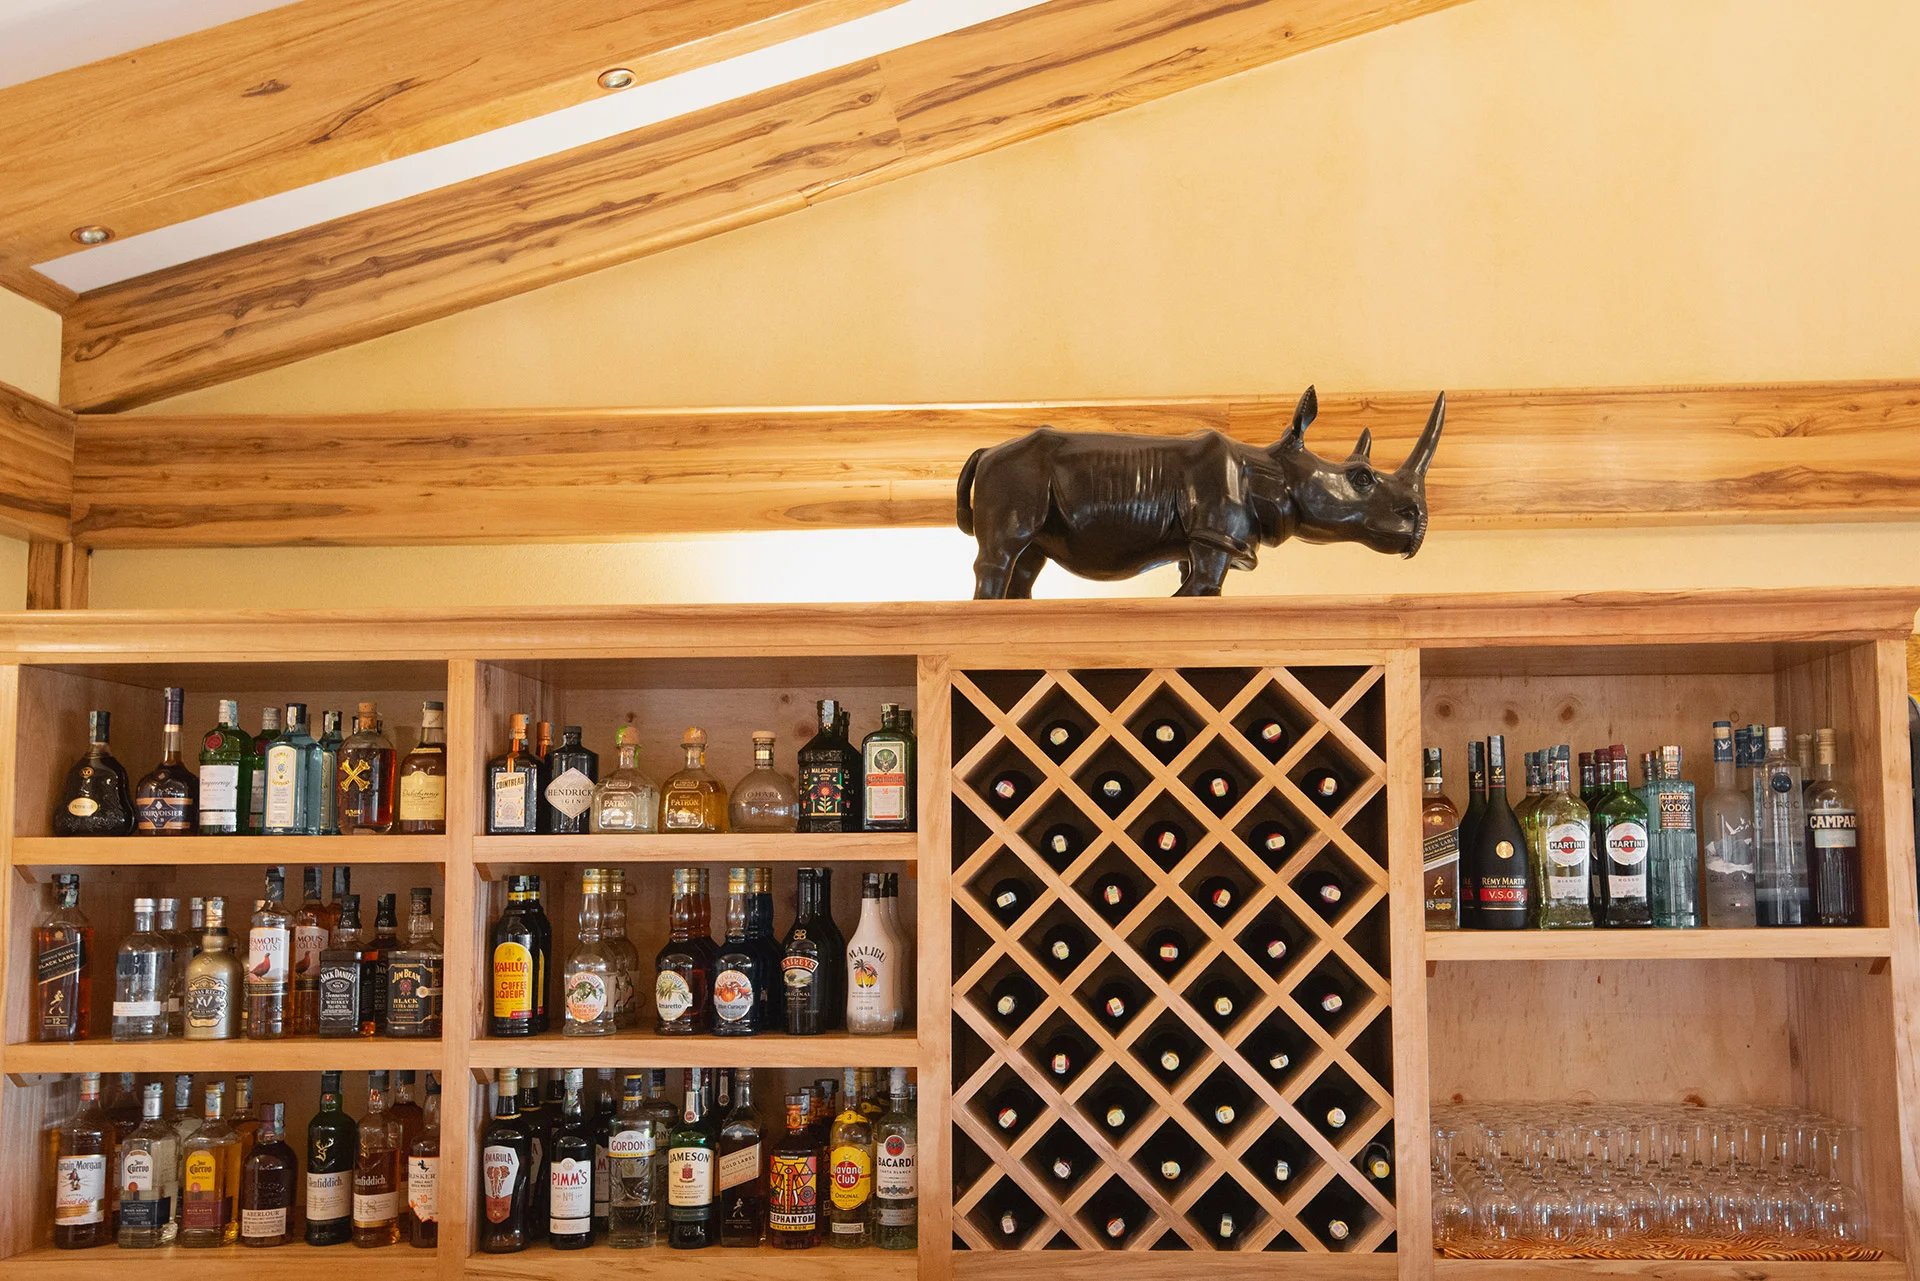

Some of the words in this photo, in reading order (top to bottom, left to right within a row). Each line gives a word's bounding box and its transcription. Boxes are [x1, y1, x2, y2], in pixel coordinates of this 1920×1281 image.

[495, 776, 525, 791] COINTREAU
[1661, 804, 1691, 812] VODKA
[1550, 841, 1585, 849] MARTINI
[1610, 840, 1645, 848] MARTINI
[1426, 900, 1435, 909] 15
[494, 960, 529, 973] KAHLÚA
[782, 957, 815, 970] BAILEYS
[320, 972, 335, 983] JACK
[392, 971, 403, 984] JIM
[403, 968, 421, 983] BEAM
[501, 981, 527, 990] COFFEE
[495, 990, 526, 999] LIQUEUR
[196, 996, 213, 1009] XV
[52, 1016, 61, 1025] 12
[486, 1152, 514, 1165] AMARULA
[669, 1152, 710, 1164] JAMESON
[721, 1161, 738, 1171] GOLD
[738, 1155, 756, 1165] LABEL
[878, 1155, 915, 1168] BACARDÍ
[76, 1160, 102, 1171] Morgan
[127, 1164, 150, 1174] Cuervo
[189, 1164, 212, 1174] Cuervo
[832, 1166, 862, 1174] Havana
[551, 1169, 588, 1186] PIMM'S
[836, 1174, 856, 1184] Club
